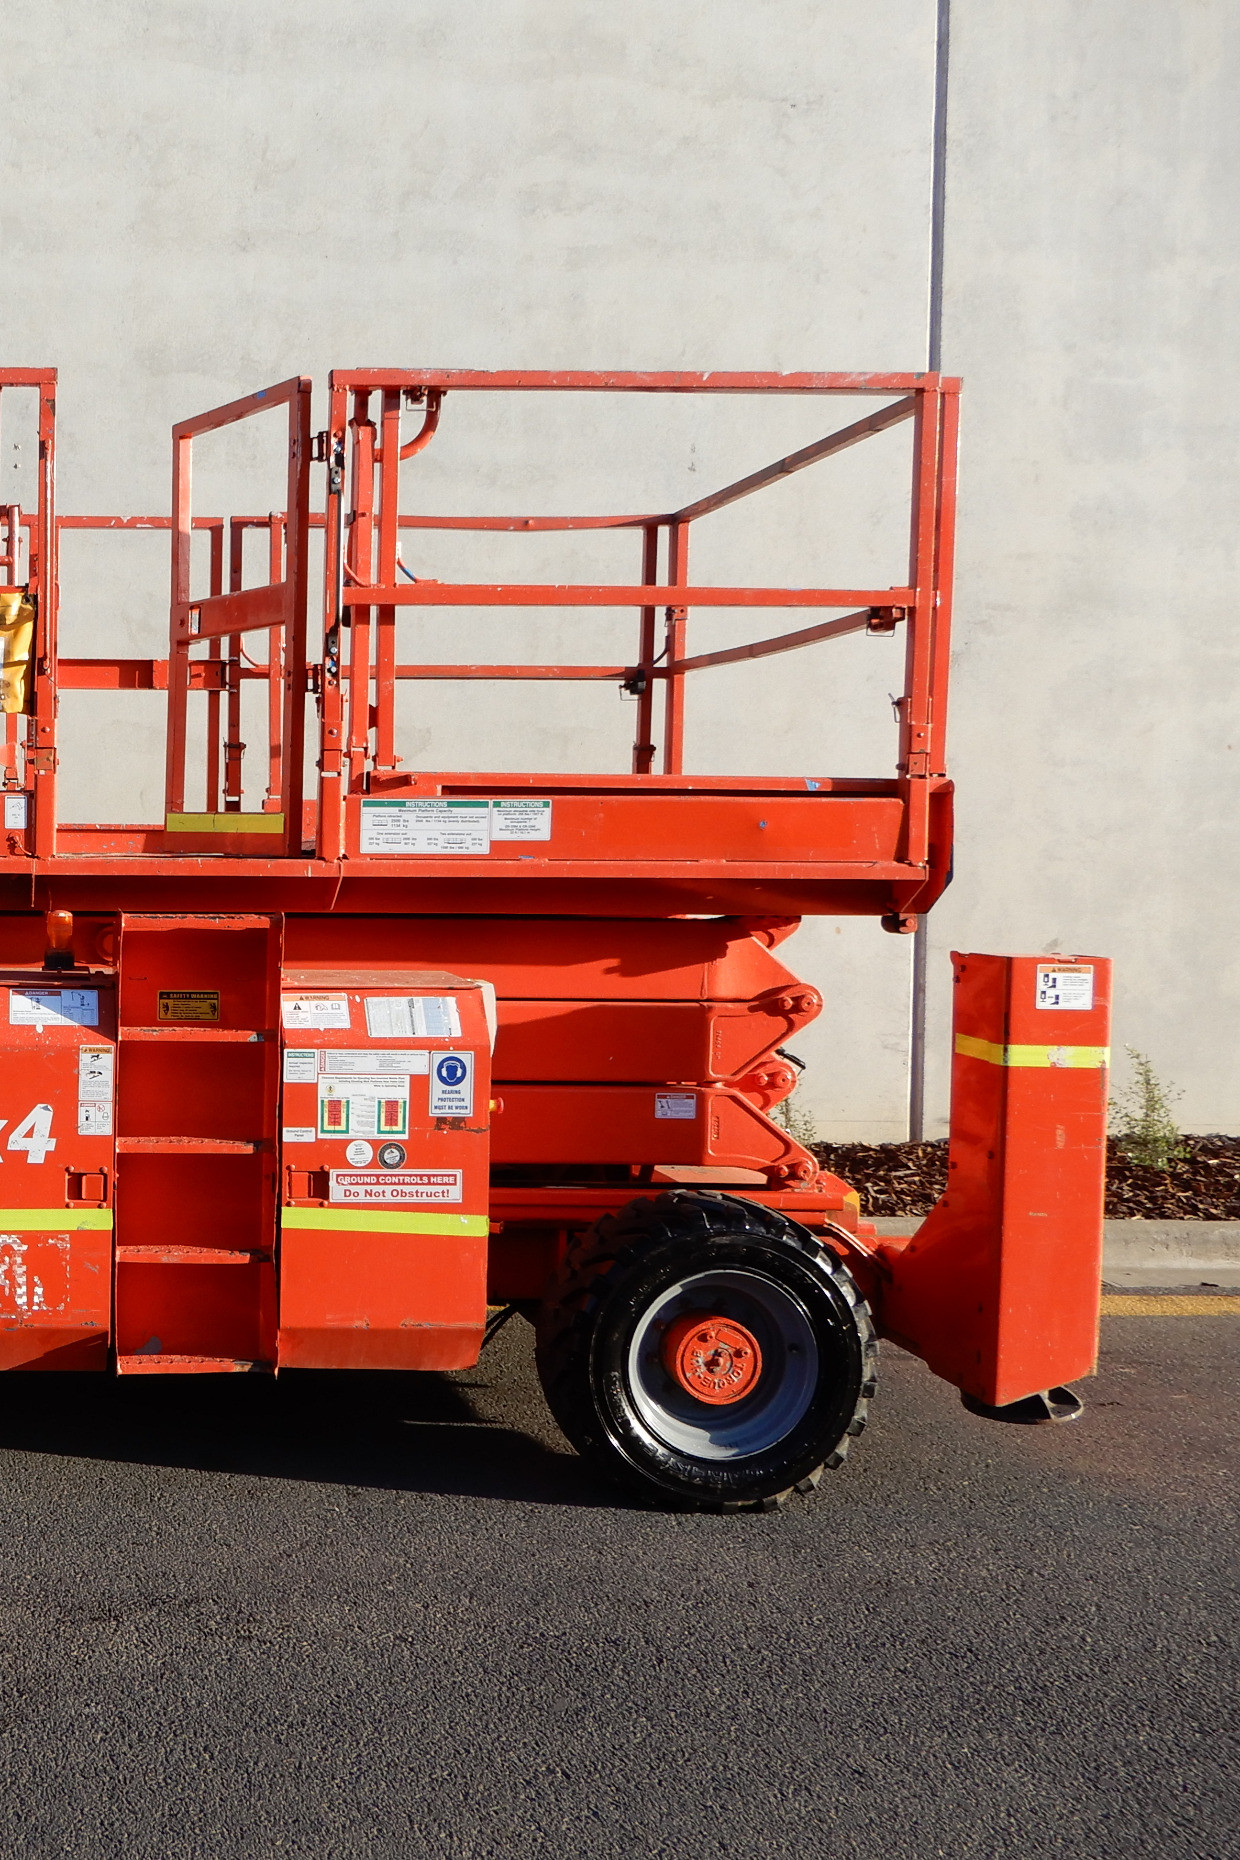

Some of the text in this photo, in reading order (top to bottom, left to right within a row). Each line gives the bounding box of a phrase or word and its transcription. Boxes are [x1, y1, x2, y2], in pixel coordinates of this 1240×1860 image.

[337, 1176, 455, 1184] GROUND CONTROLS HERE
[343, 1188, 450, 1198] Do Not Obstruct!
